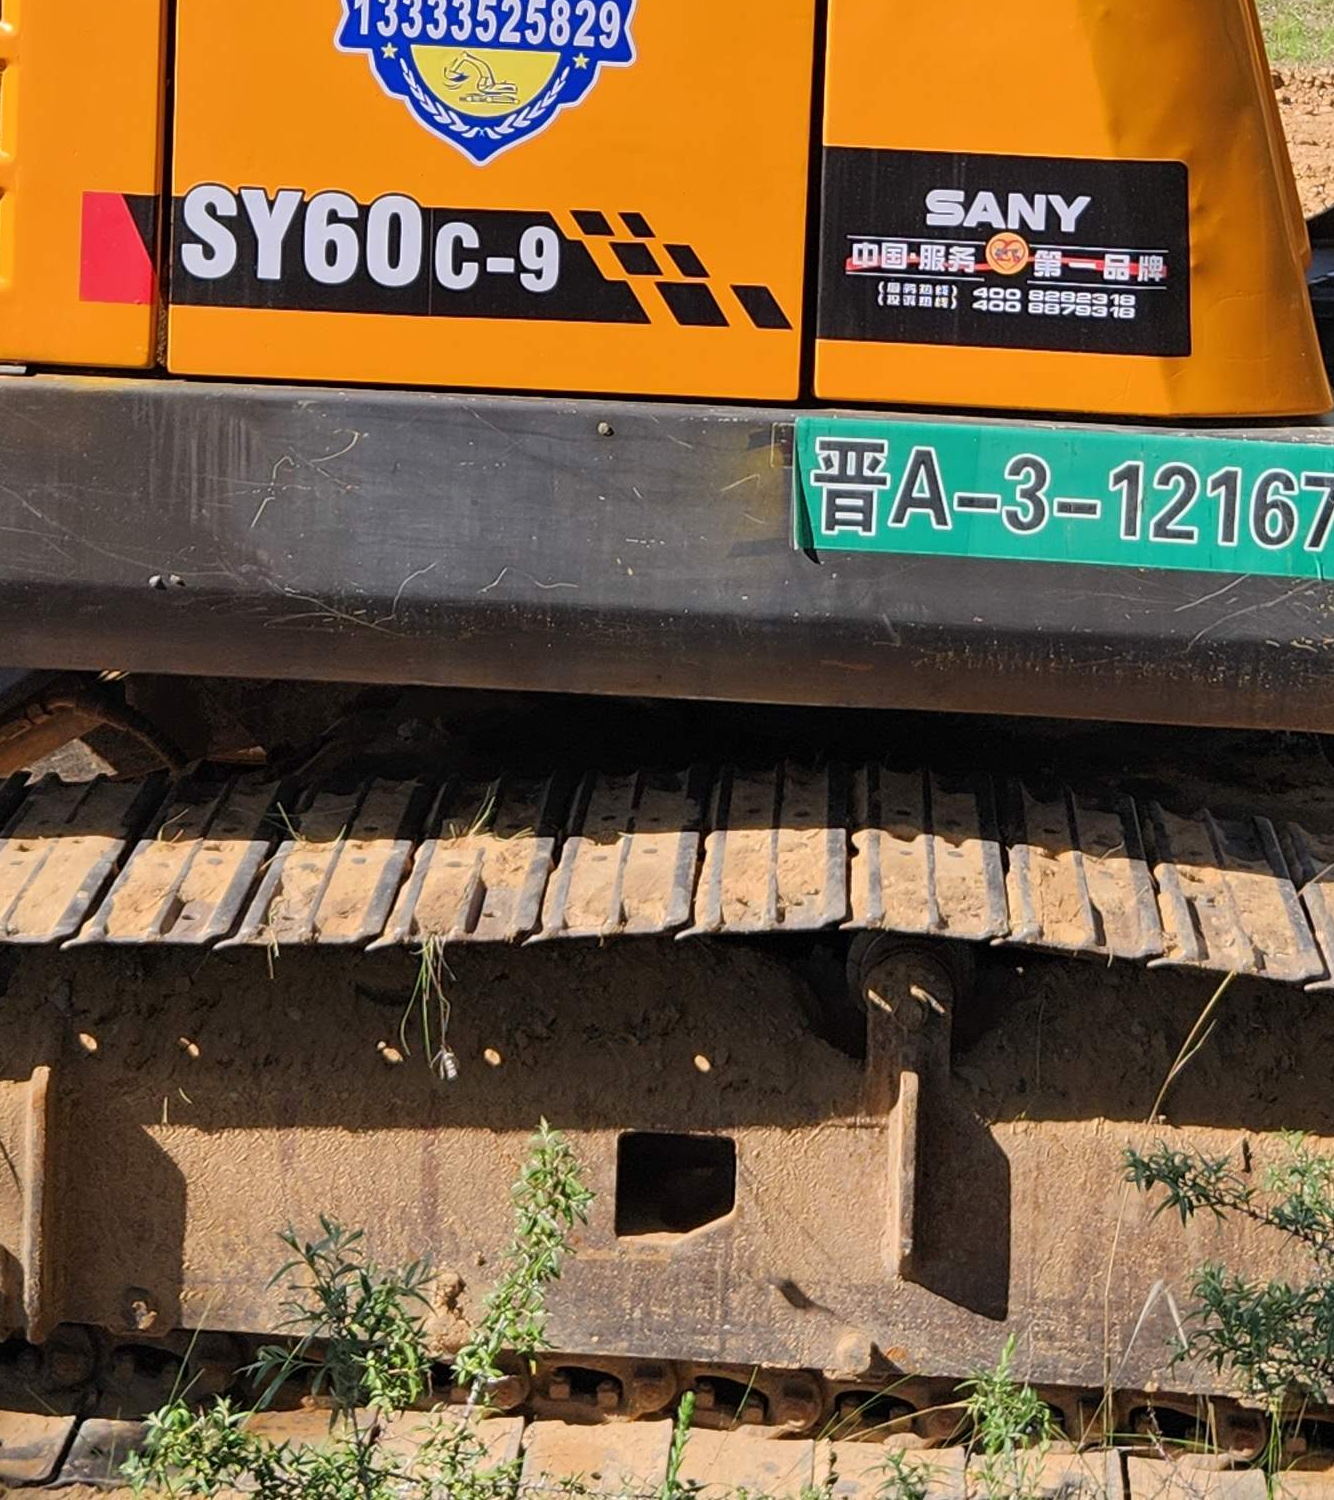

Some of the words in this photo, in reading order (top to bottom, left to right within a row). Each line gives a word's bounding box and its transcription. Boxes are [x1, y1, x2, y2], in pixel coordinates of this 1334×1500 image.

[925, 188, 1092, 233] SANY
[1033, 250, 1164, 282] 第一品牌
[972, 287, 1022, 300] 400
[971, 299, 1022, 313] 400
